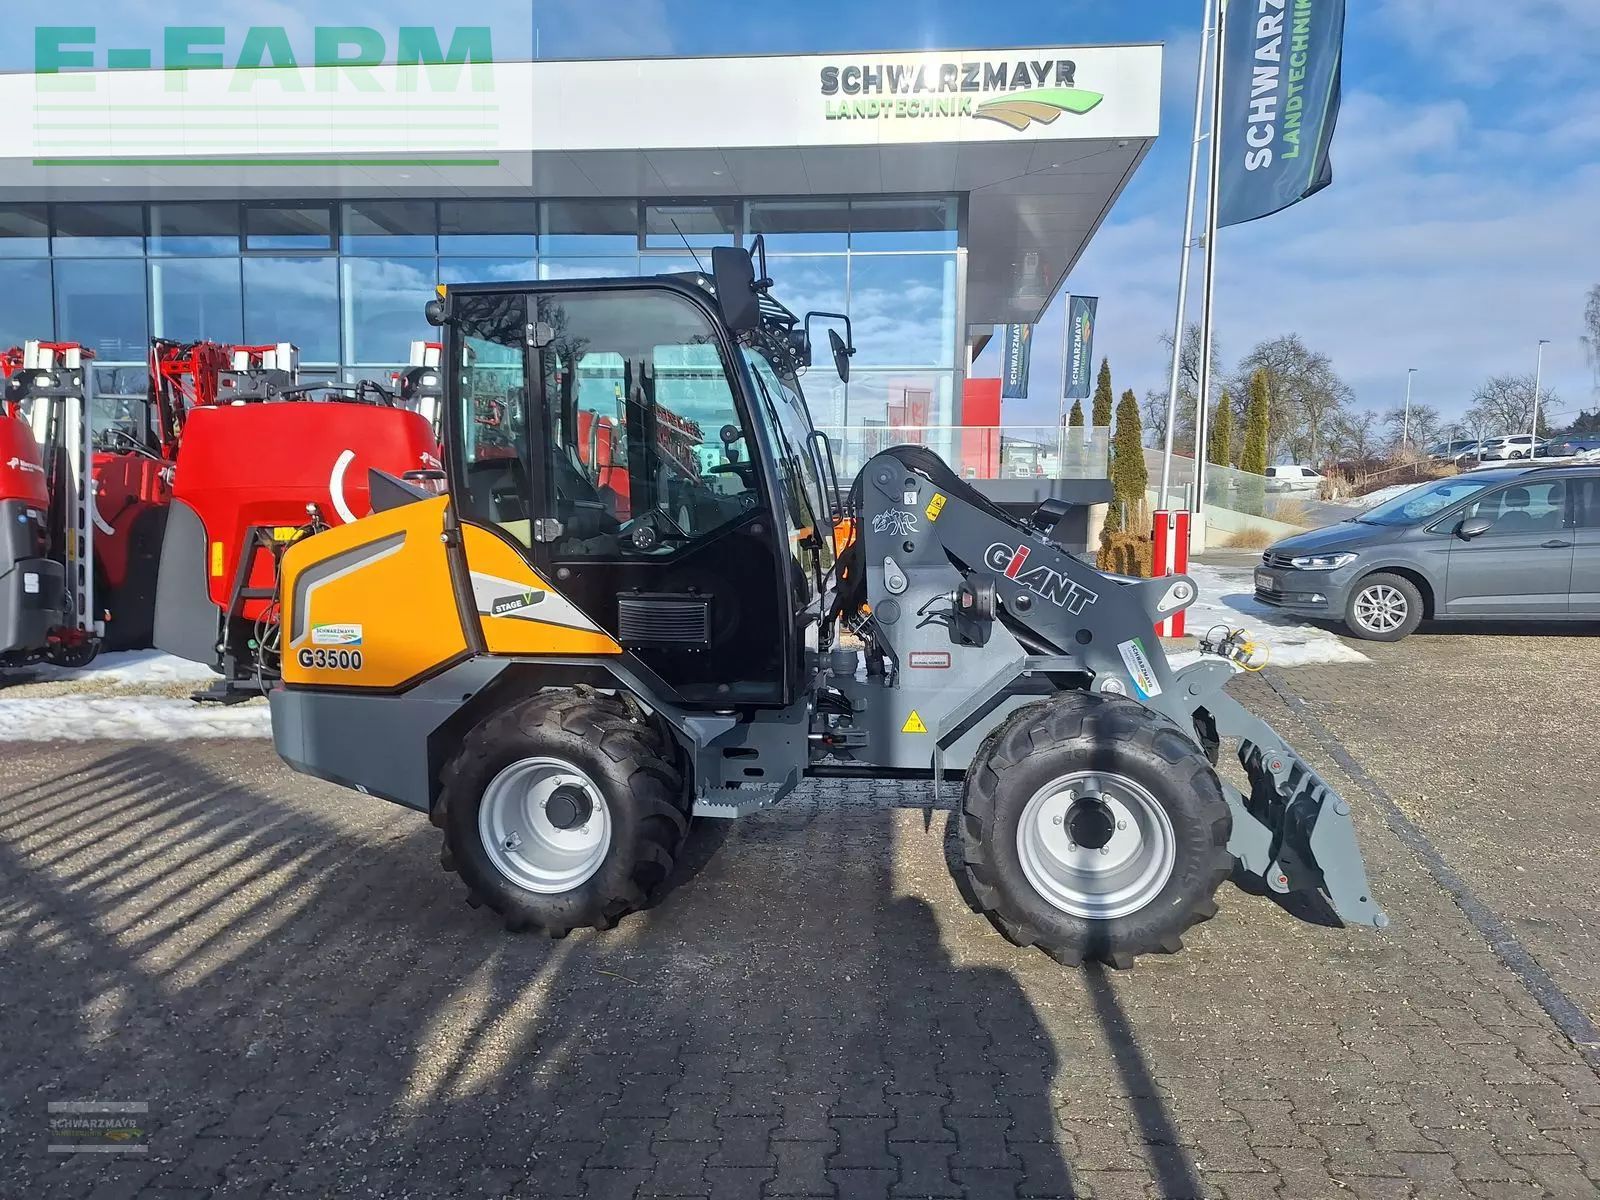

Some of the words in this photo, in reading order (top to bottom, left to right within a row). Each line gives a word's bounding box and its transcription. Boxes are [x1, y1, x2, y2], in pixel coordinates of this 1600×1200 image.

[820, 60, 1077, 96] SCHWARZMAYR
[825, 97, 974, 121] LANDTECHNIK
[1072, 316, 1082, 386] SCHWARZMAYR
[984, 542, 1099, 616] GIANT
[495, 599, 523, 613] STAGE
[298, 648, 363, 671] G3500
